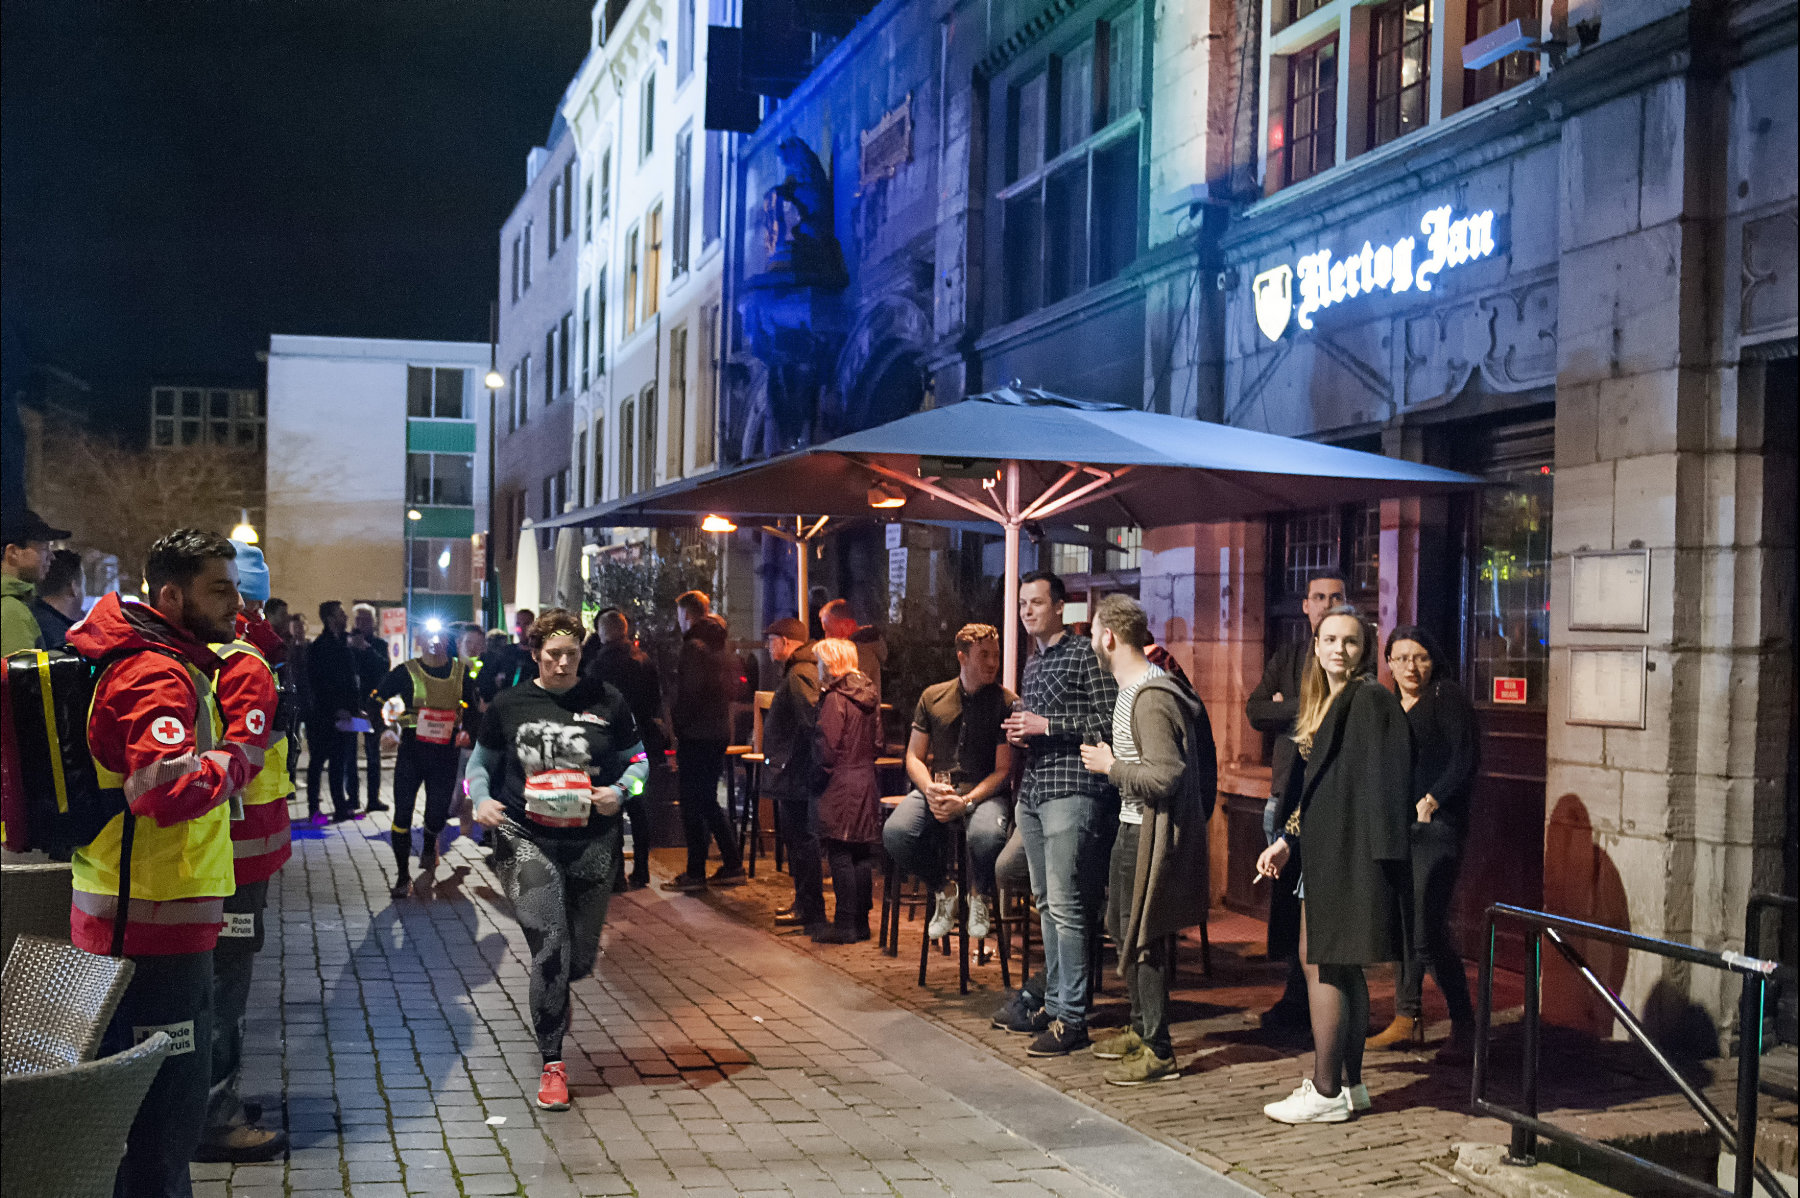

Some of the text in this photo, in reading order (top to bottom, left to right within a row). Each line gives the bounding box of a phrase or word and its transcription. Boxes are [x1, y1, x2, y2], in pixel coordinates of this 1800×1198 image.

[1297, 204, 1495, 330] Hertog Jan
[232, 917, 252, 925] Rode
[231, 926, 252, 934] Kruis
[170, 1040, 191, 1051] ruis
